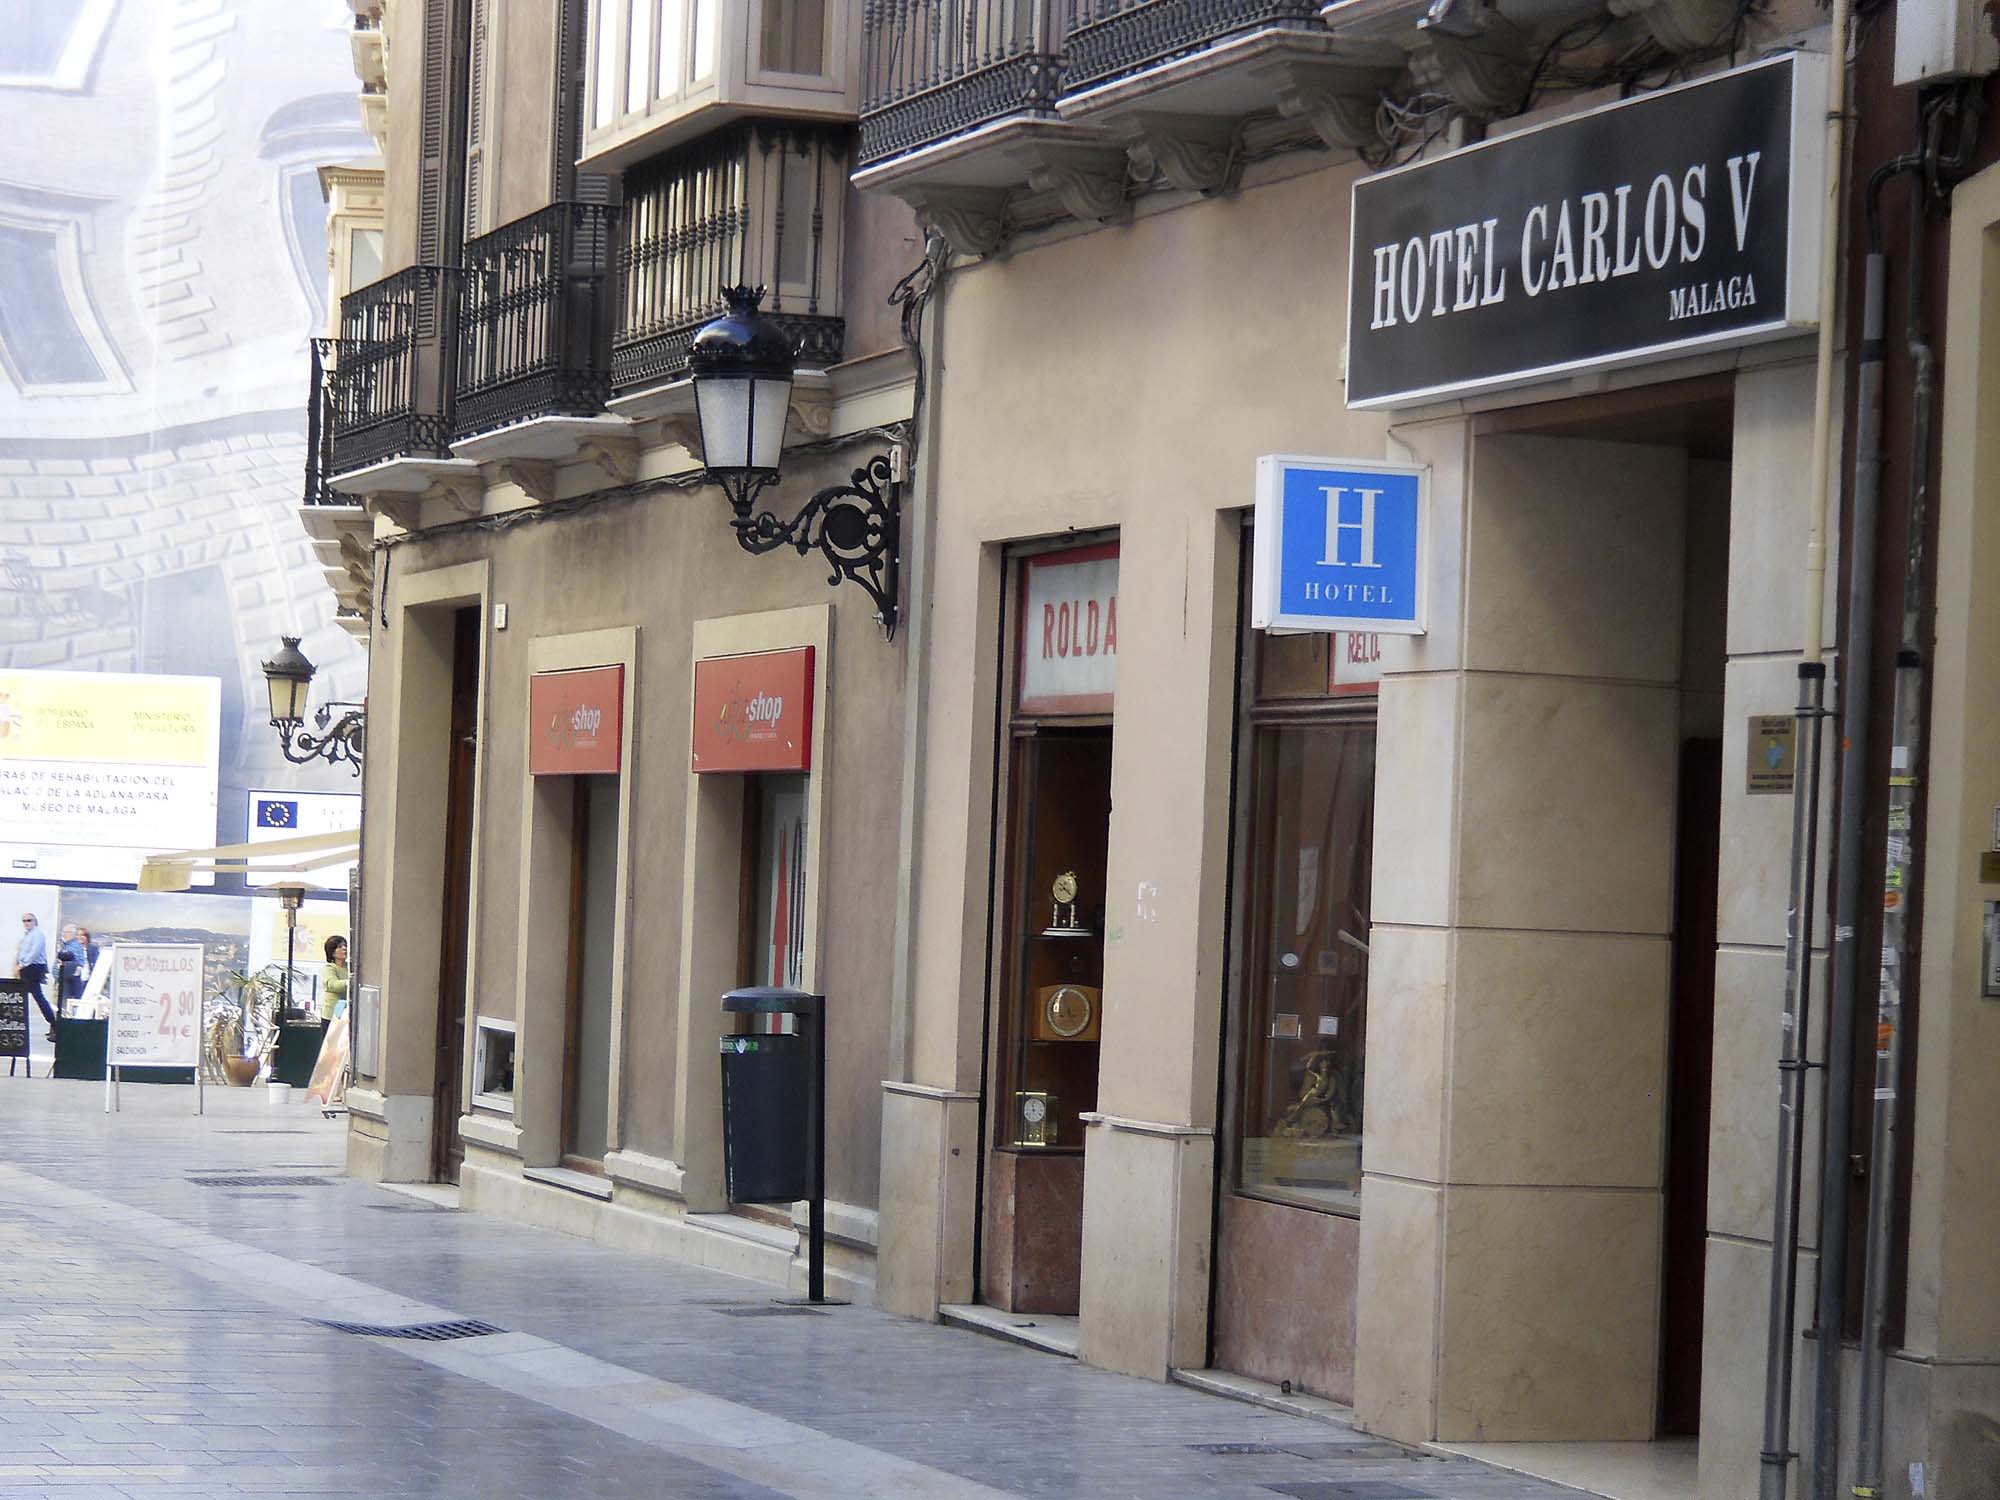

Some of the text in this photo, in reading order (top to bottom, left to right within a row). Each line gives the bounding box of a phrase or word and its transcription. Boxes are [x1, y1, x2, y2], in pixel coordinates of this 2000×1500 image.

[1371, 152, 1760, 330] HOTEL CARLOS V
[1669, 273, 1757, 320] MALAGA
[1316, 486, 1384, 569] H
[1305, 582, 1393, 605] HOTEL
[1042, 596, 1118, 659] ROLDA
[574, 703, 601, 737] shop
[749, 690, 783, 729] shop
[47, 787, 62, 797] DE
[66, 788, 81, 798] LA
[67, 803, 82, 814] DE
